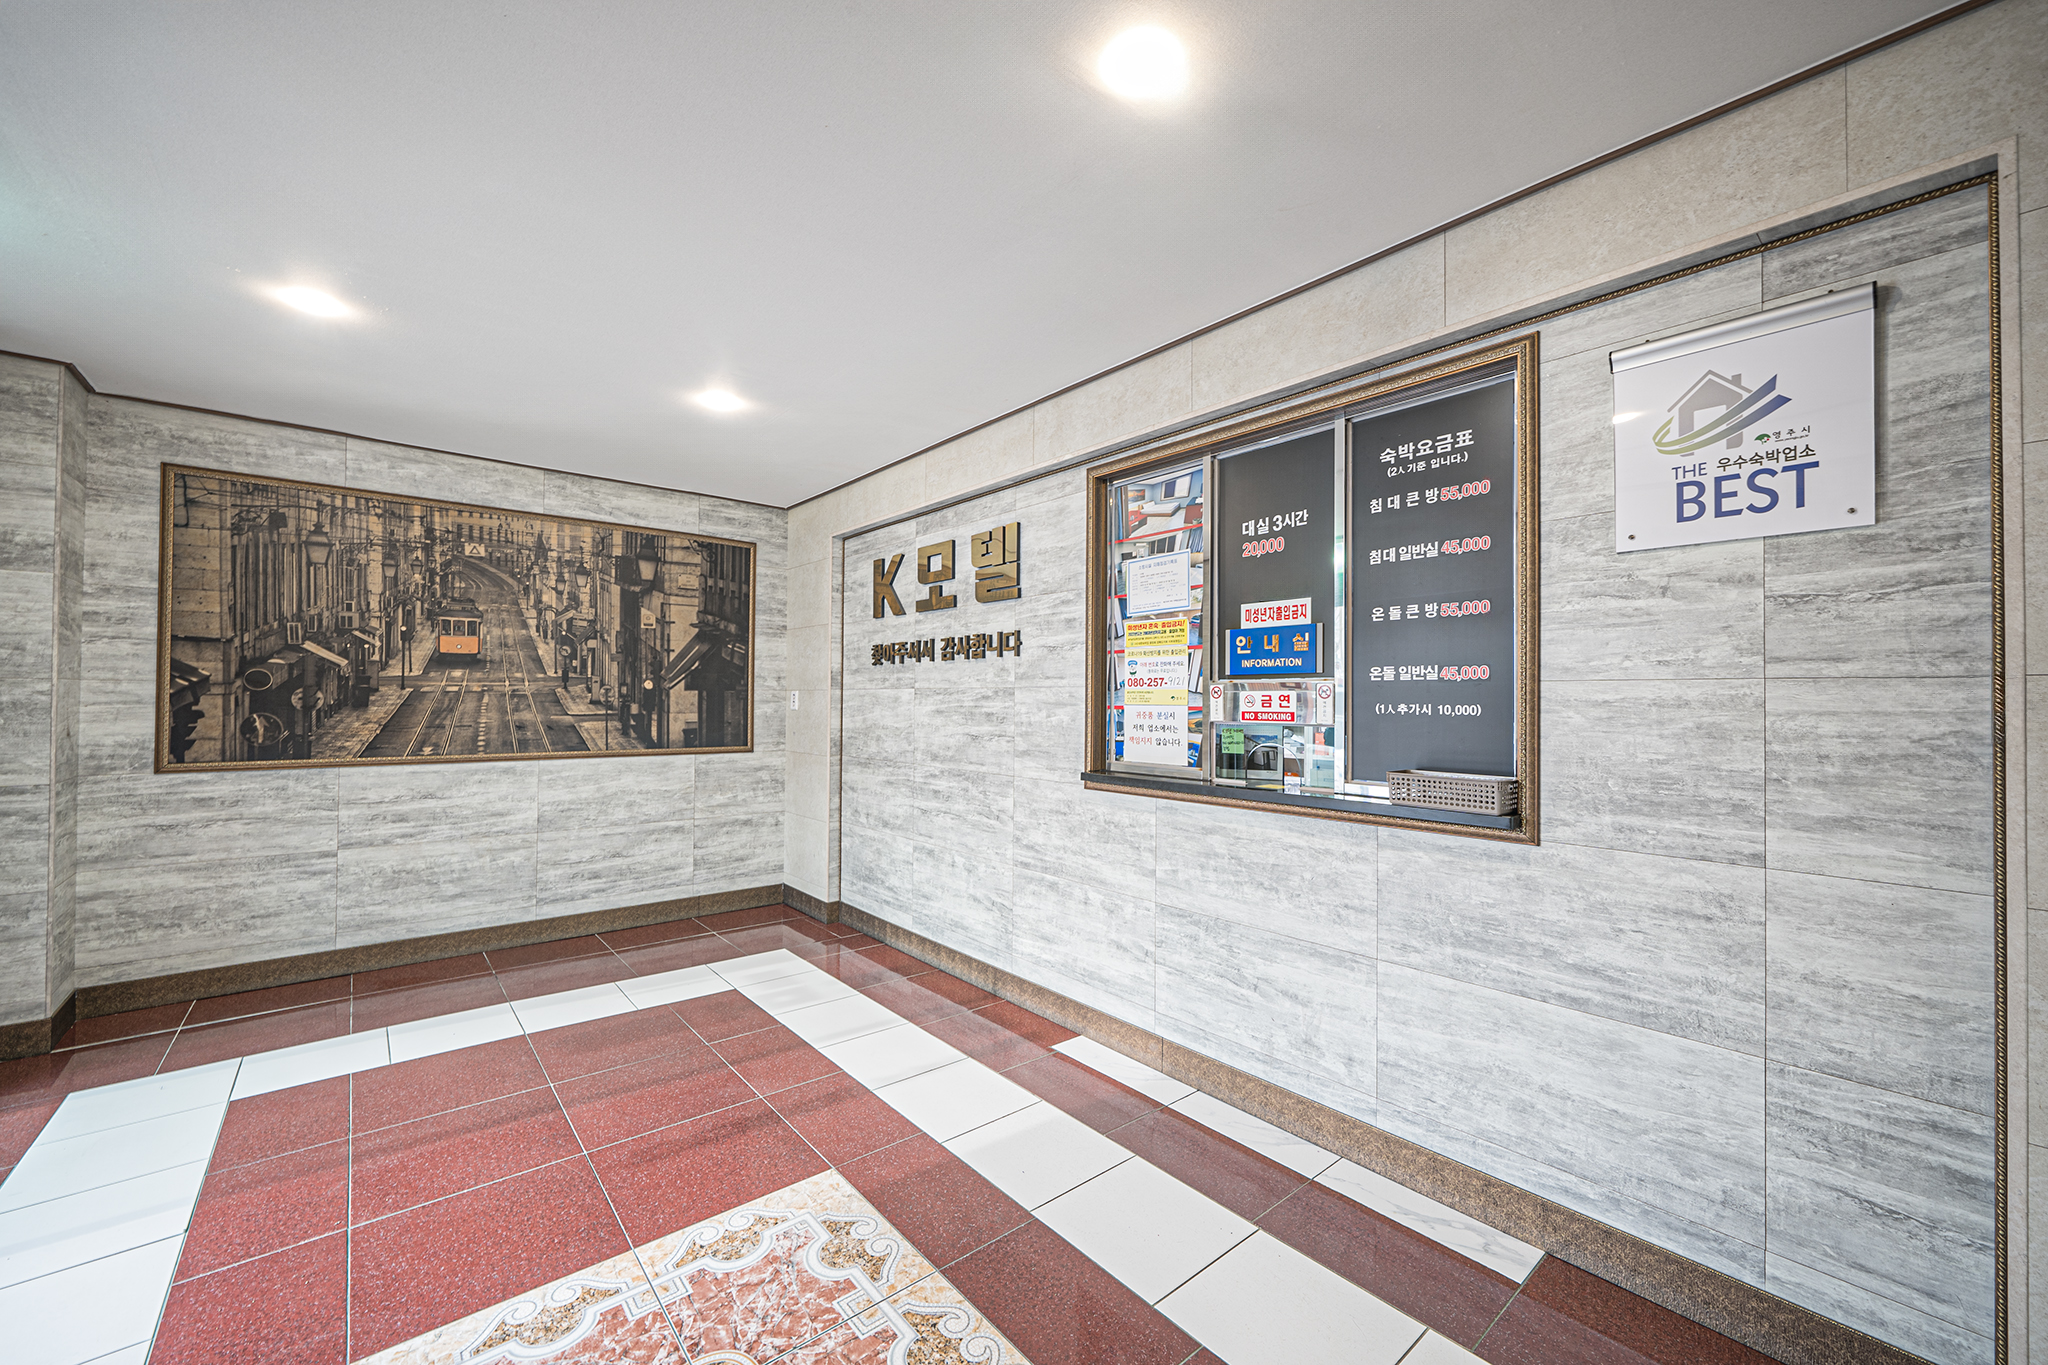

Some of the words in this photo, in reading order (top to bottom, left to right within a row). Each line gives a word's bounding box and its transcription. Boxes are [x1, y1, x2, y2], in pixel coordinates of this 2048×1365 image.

[1772, 425, 1810, 439] 영주시
[1379, 429, 1474, 464] 숙박요금표
[1430, 451, 1469, 469] 입니다.)
[1716, 443, 1816, 472] 우수숙박업소
[1672, 462, 1707, 480] THE
[1440, 479, 1491, 501] 55,000
[1676, 461, 1819, 523] BEST
[1272, 509, 1309, 531] 3시간
[1242, 536, 1285, 558] 20,000
[1369, 546, 1396, 566] 침대
[1399, 541, 1439, 562] 일반실
[1440, 535, 1491, 556] 45,000
[1245, 603, 1307, 623] 미성년자출입금지
[1440, 599, 1491, 618] 55,000
[1128, 623, 1148, 631] 미성년자
[871, 638, 935, 666] 찾아주셔서
[940, 629, 1023, 662] 감사합니다
[1241, 658, 1302, 668] INFORMATION
[1369, 666, 1396, 681] 온돌
[1398, 664, 1439, 681] 일반실
[1440, 665, 1490, 682] 45,000
[1261, 694, 1290, 708] 금연
[1157, 711, 1175, 720] 분실시
[1437, 703, 1482, 718] 10,000)
[1133, 723, 1144, 732] 저희
[1148, 724, 1178, 734] 업소에서는
[1129, 736, 1152, 745] 책임지지
[1155, 737, 1183, 747] 않습니다.
